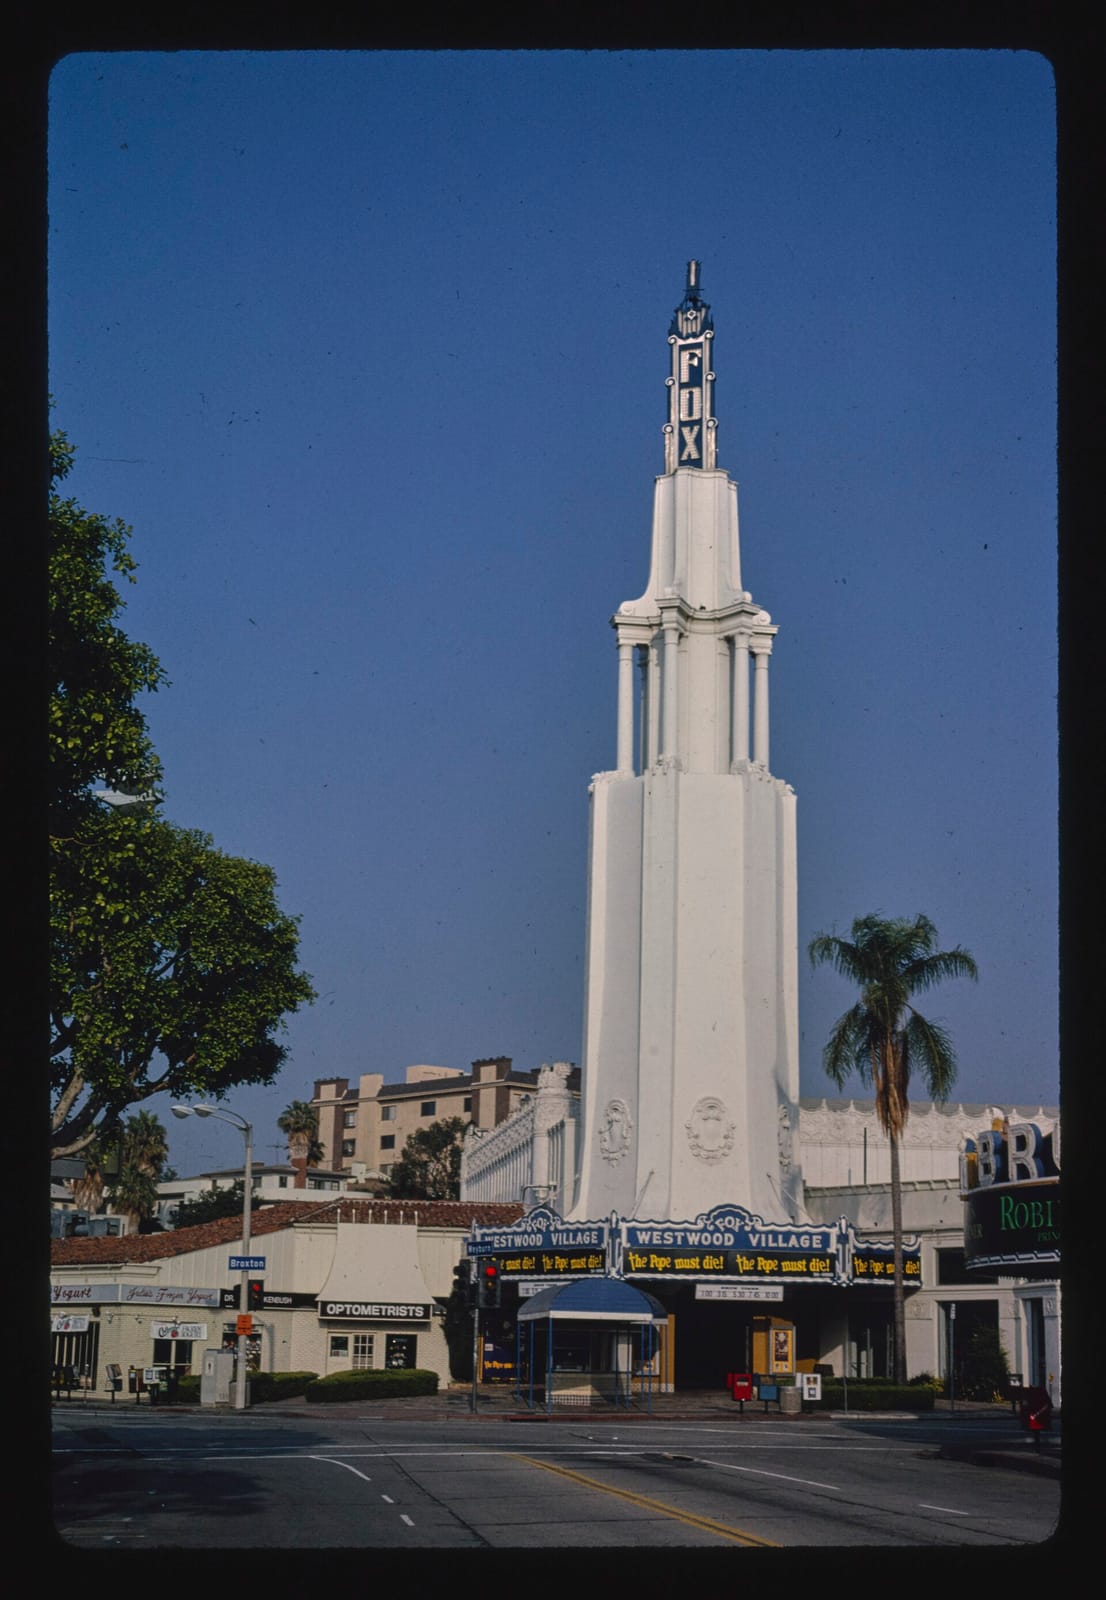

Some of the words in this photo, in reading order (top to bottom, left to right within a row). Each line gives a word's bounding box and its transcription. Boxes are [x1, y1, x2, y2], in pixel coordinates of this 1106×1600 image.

[679, 349, 702, 461] FOX
[551, 1231, 599, 1246] VILLAGE
[636, 1230, 735, 1246] WESTWOOD
[748, 1233, 823, 1249] VILLAGE
[230, 1259, 265, 1268] Broxton
[628, 1251, 648, 1272] the
[649, 1254, 672, 1272] Pope
[674, 1256, 700, 1270] must
[702, 1256, 724, 1270] die!
[735, 1254, 756, 1274] the
[757, 1257, 779, 1273] Pope
[781, 1259, 807, 1272] must
[809, 1258, 831, 1272] die!
[326, 1303, 425, 1318] OPTOMETRISTS
